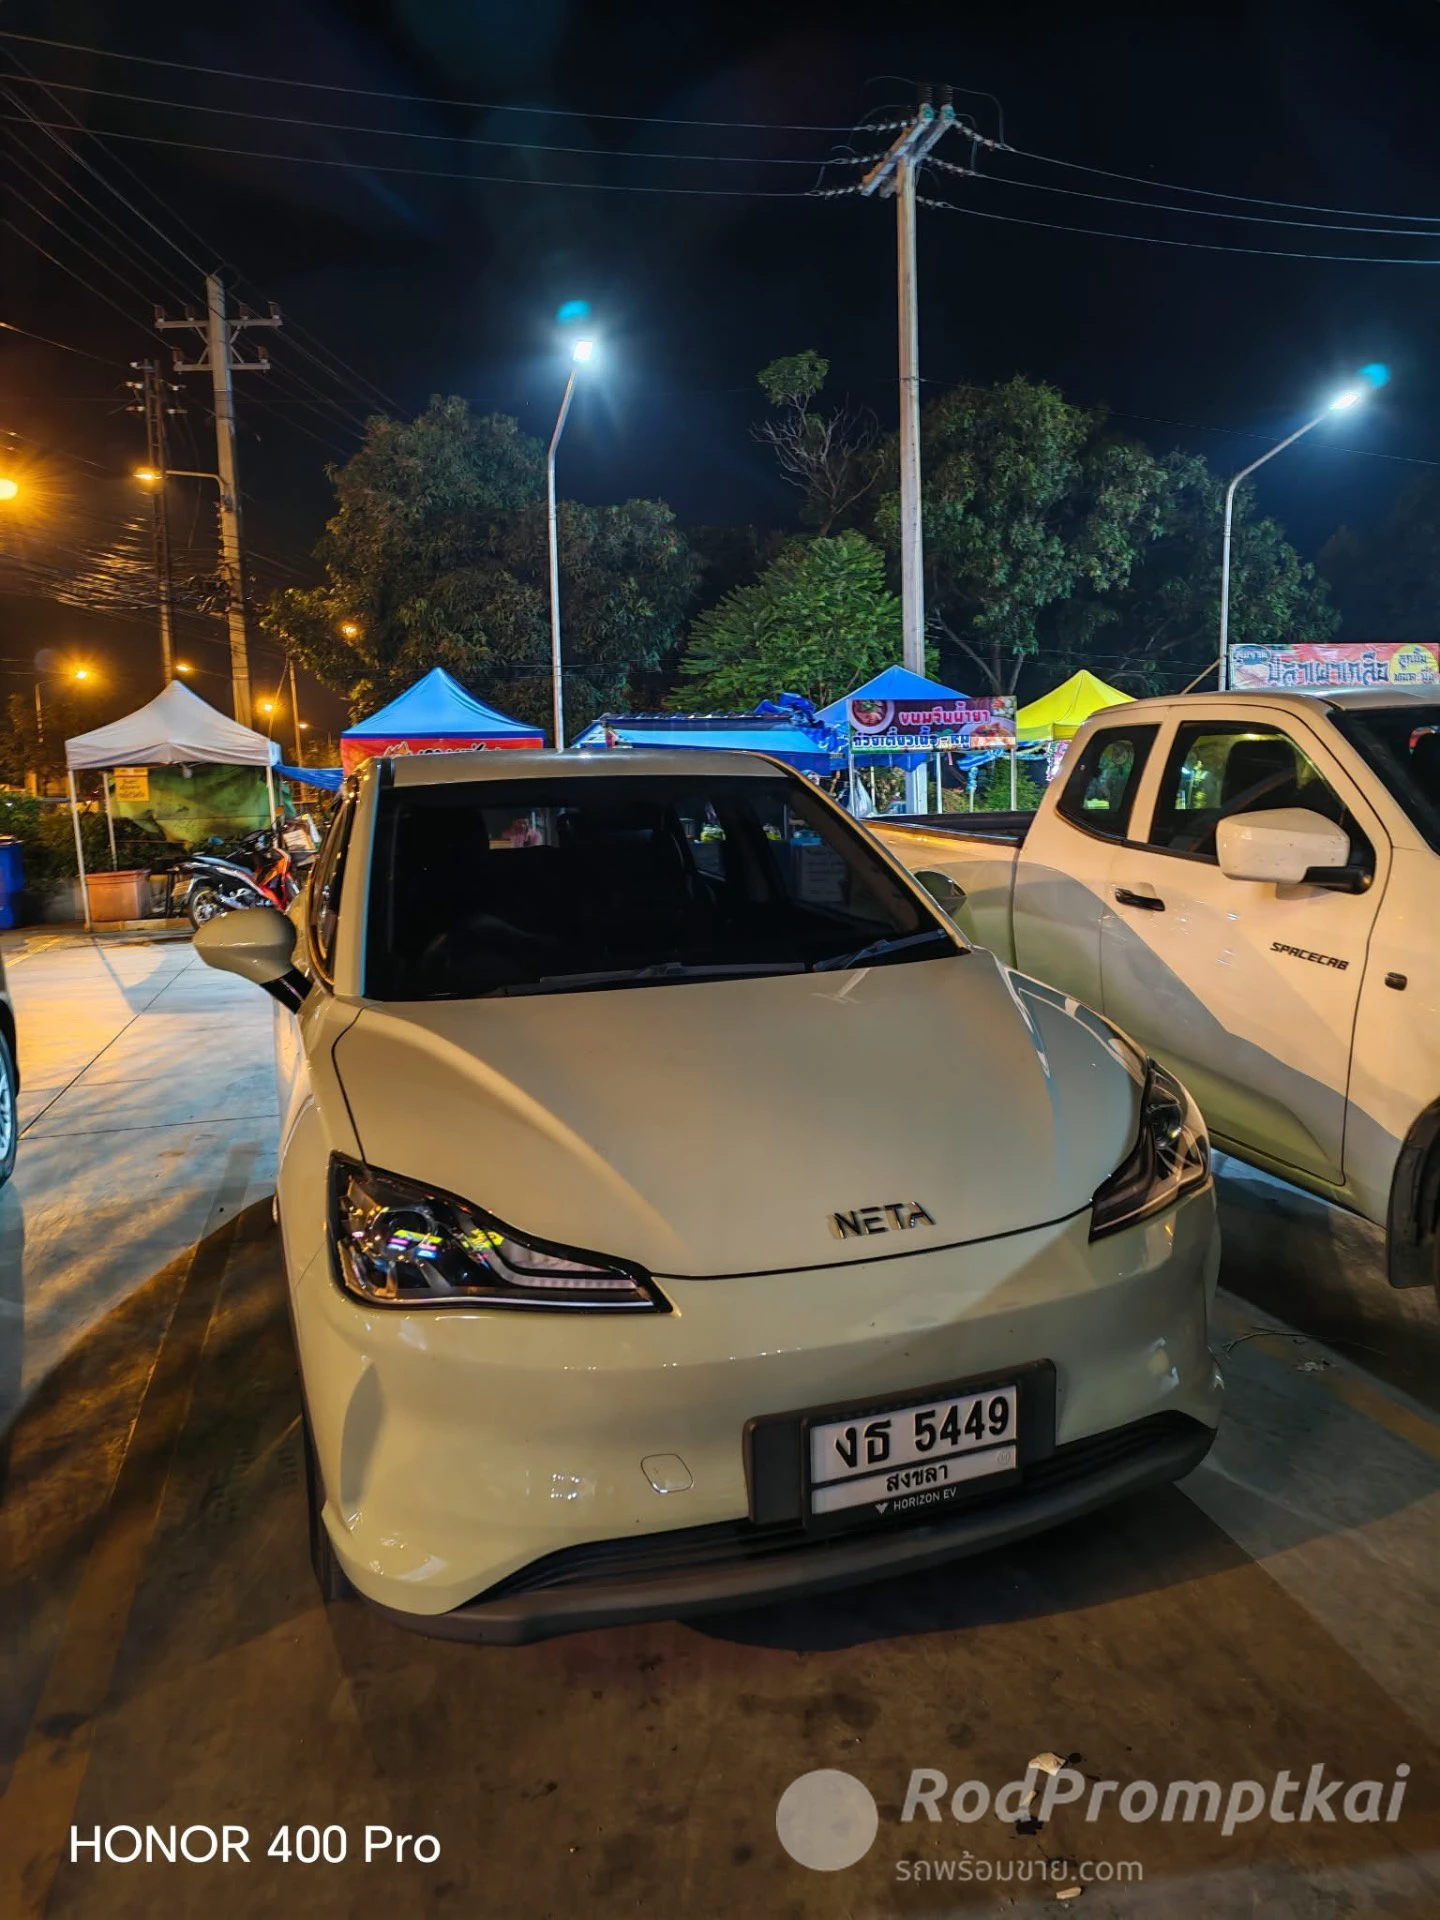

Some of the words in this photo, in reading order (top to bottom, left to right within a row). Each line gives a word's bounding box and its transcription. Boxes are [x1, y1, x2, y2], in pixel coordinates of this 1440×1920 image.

[900, 702, 991, 725] ขนมจีนน้ำยา
[1270, 942, 1349, 971] SPACECAB
[827, 1201, 936, 1239] NETA
[835, 1419, 892, 1468] งธ
[913, 1396, 1010, 1452] 5449
[886, 1464, 949, 1492] สงขลา
[893, 1492, 941, 1511] HORIZON
[943, 1487, 957, 1500] EV
